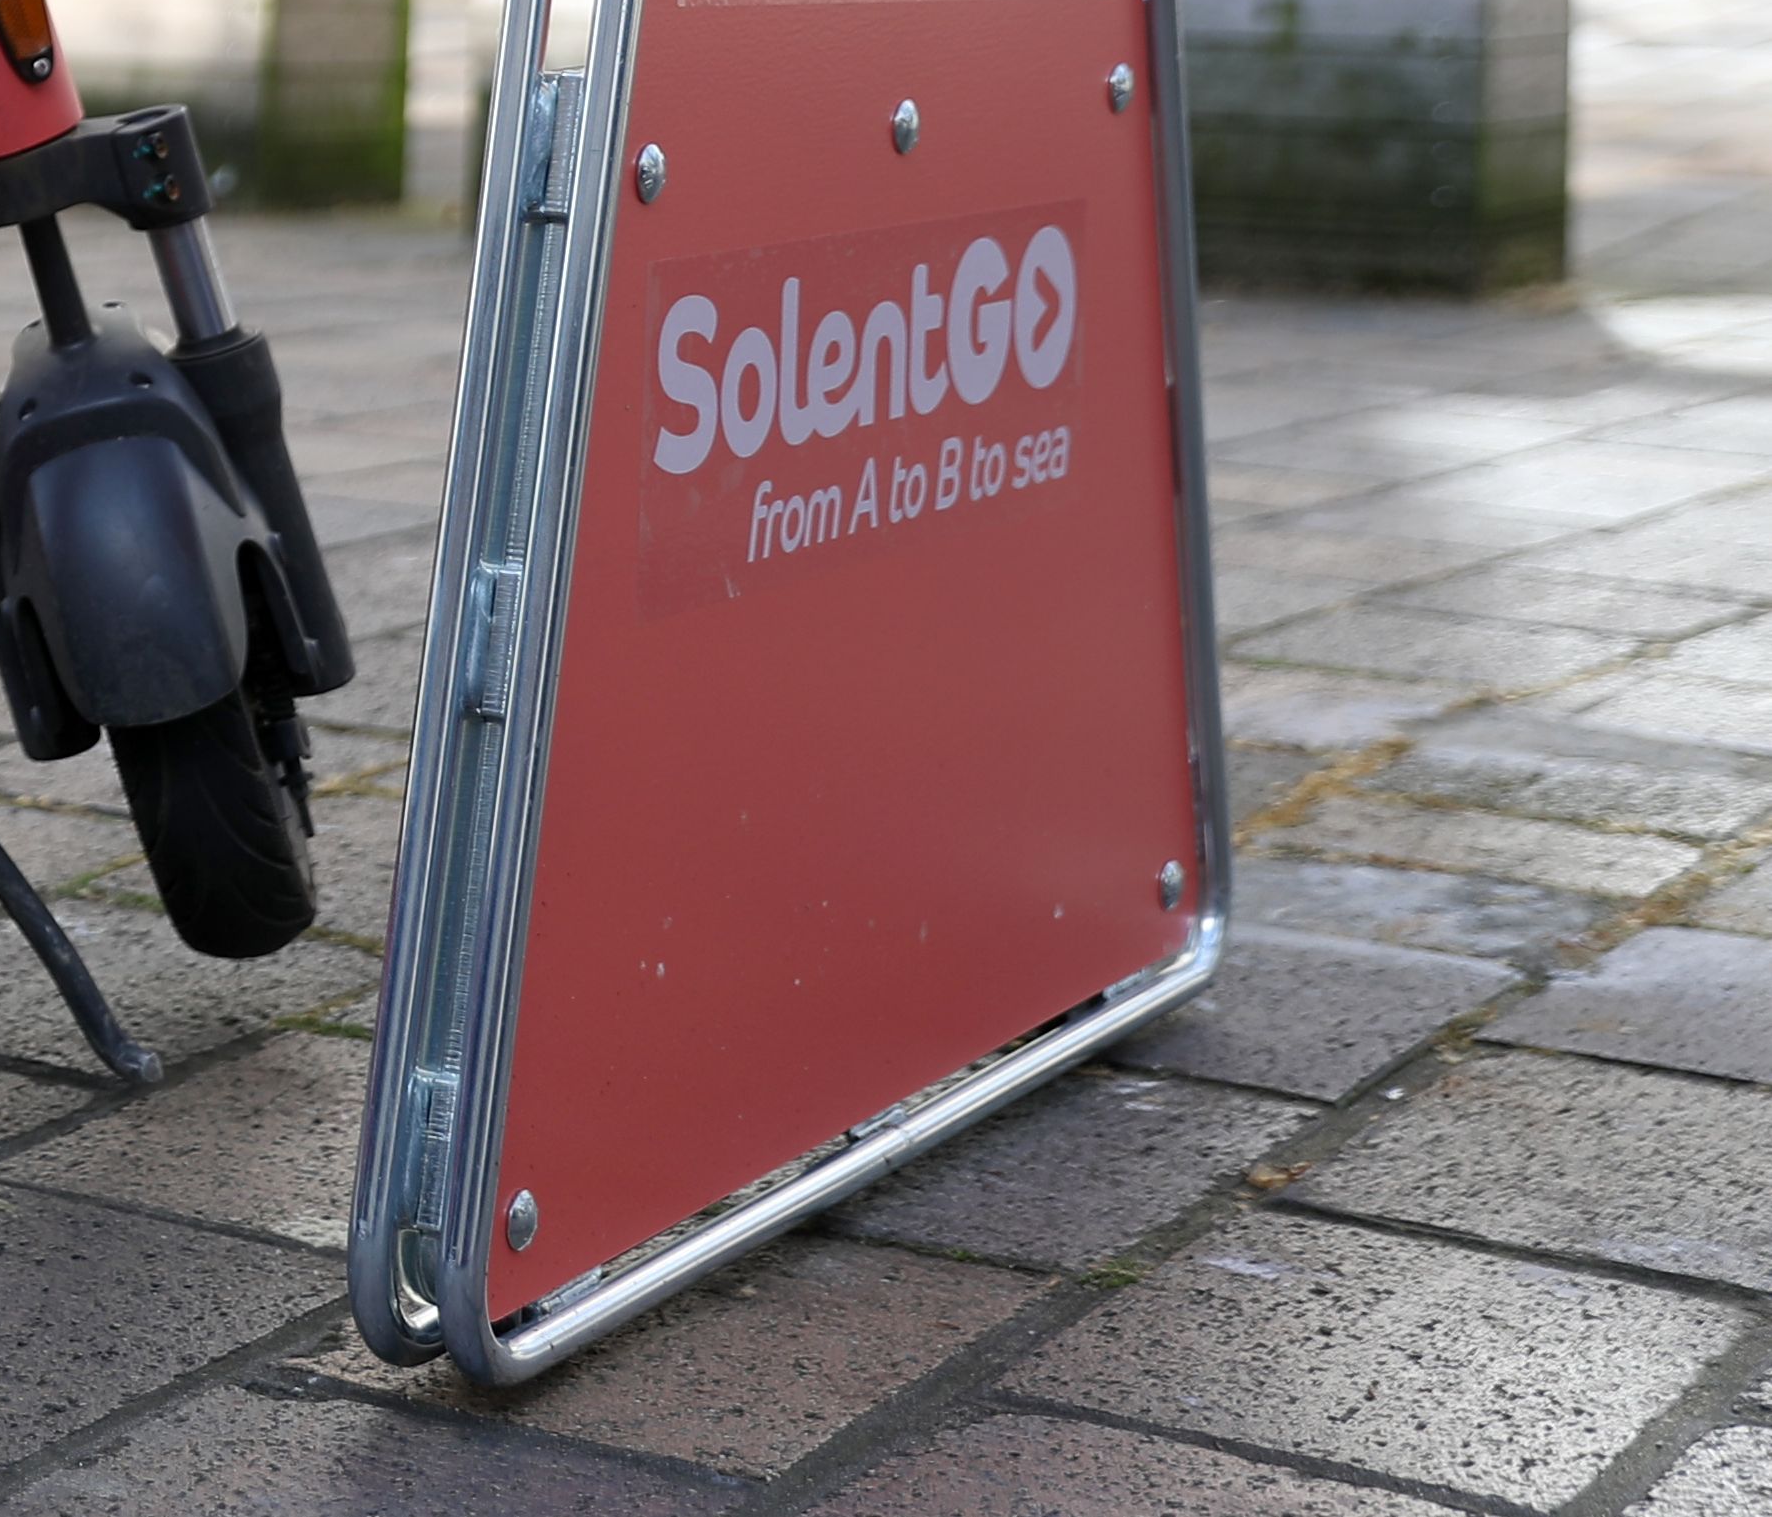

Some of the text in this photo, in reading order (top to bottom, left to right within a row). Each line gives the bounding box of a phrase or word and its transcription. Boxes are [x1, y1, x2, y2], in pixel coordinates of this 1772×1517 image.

[653, 225, 1077, 474] SolentGO
[747, 425, 1070, 562] from A to B to sea
